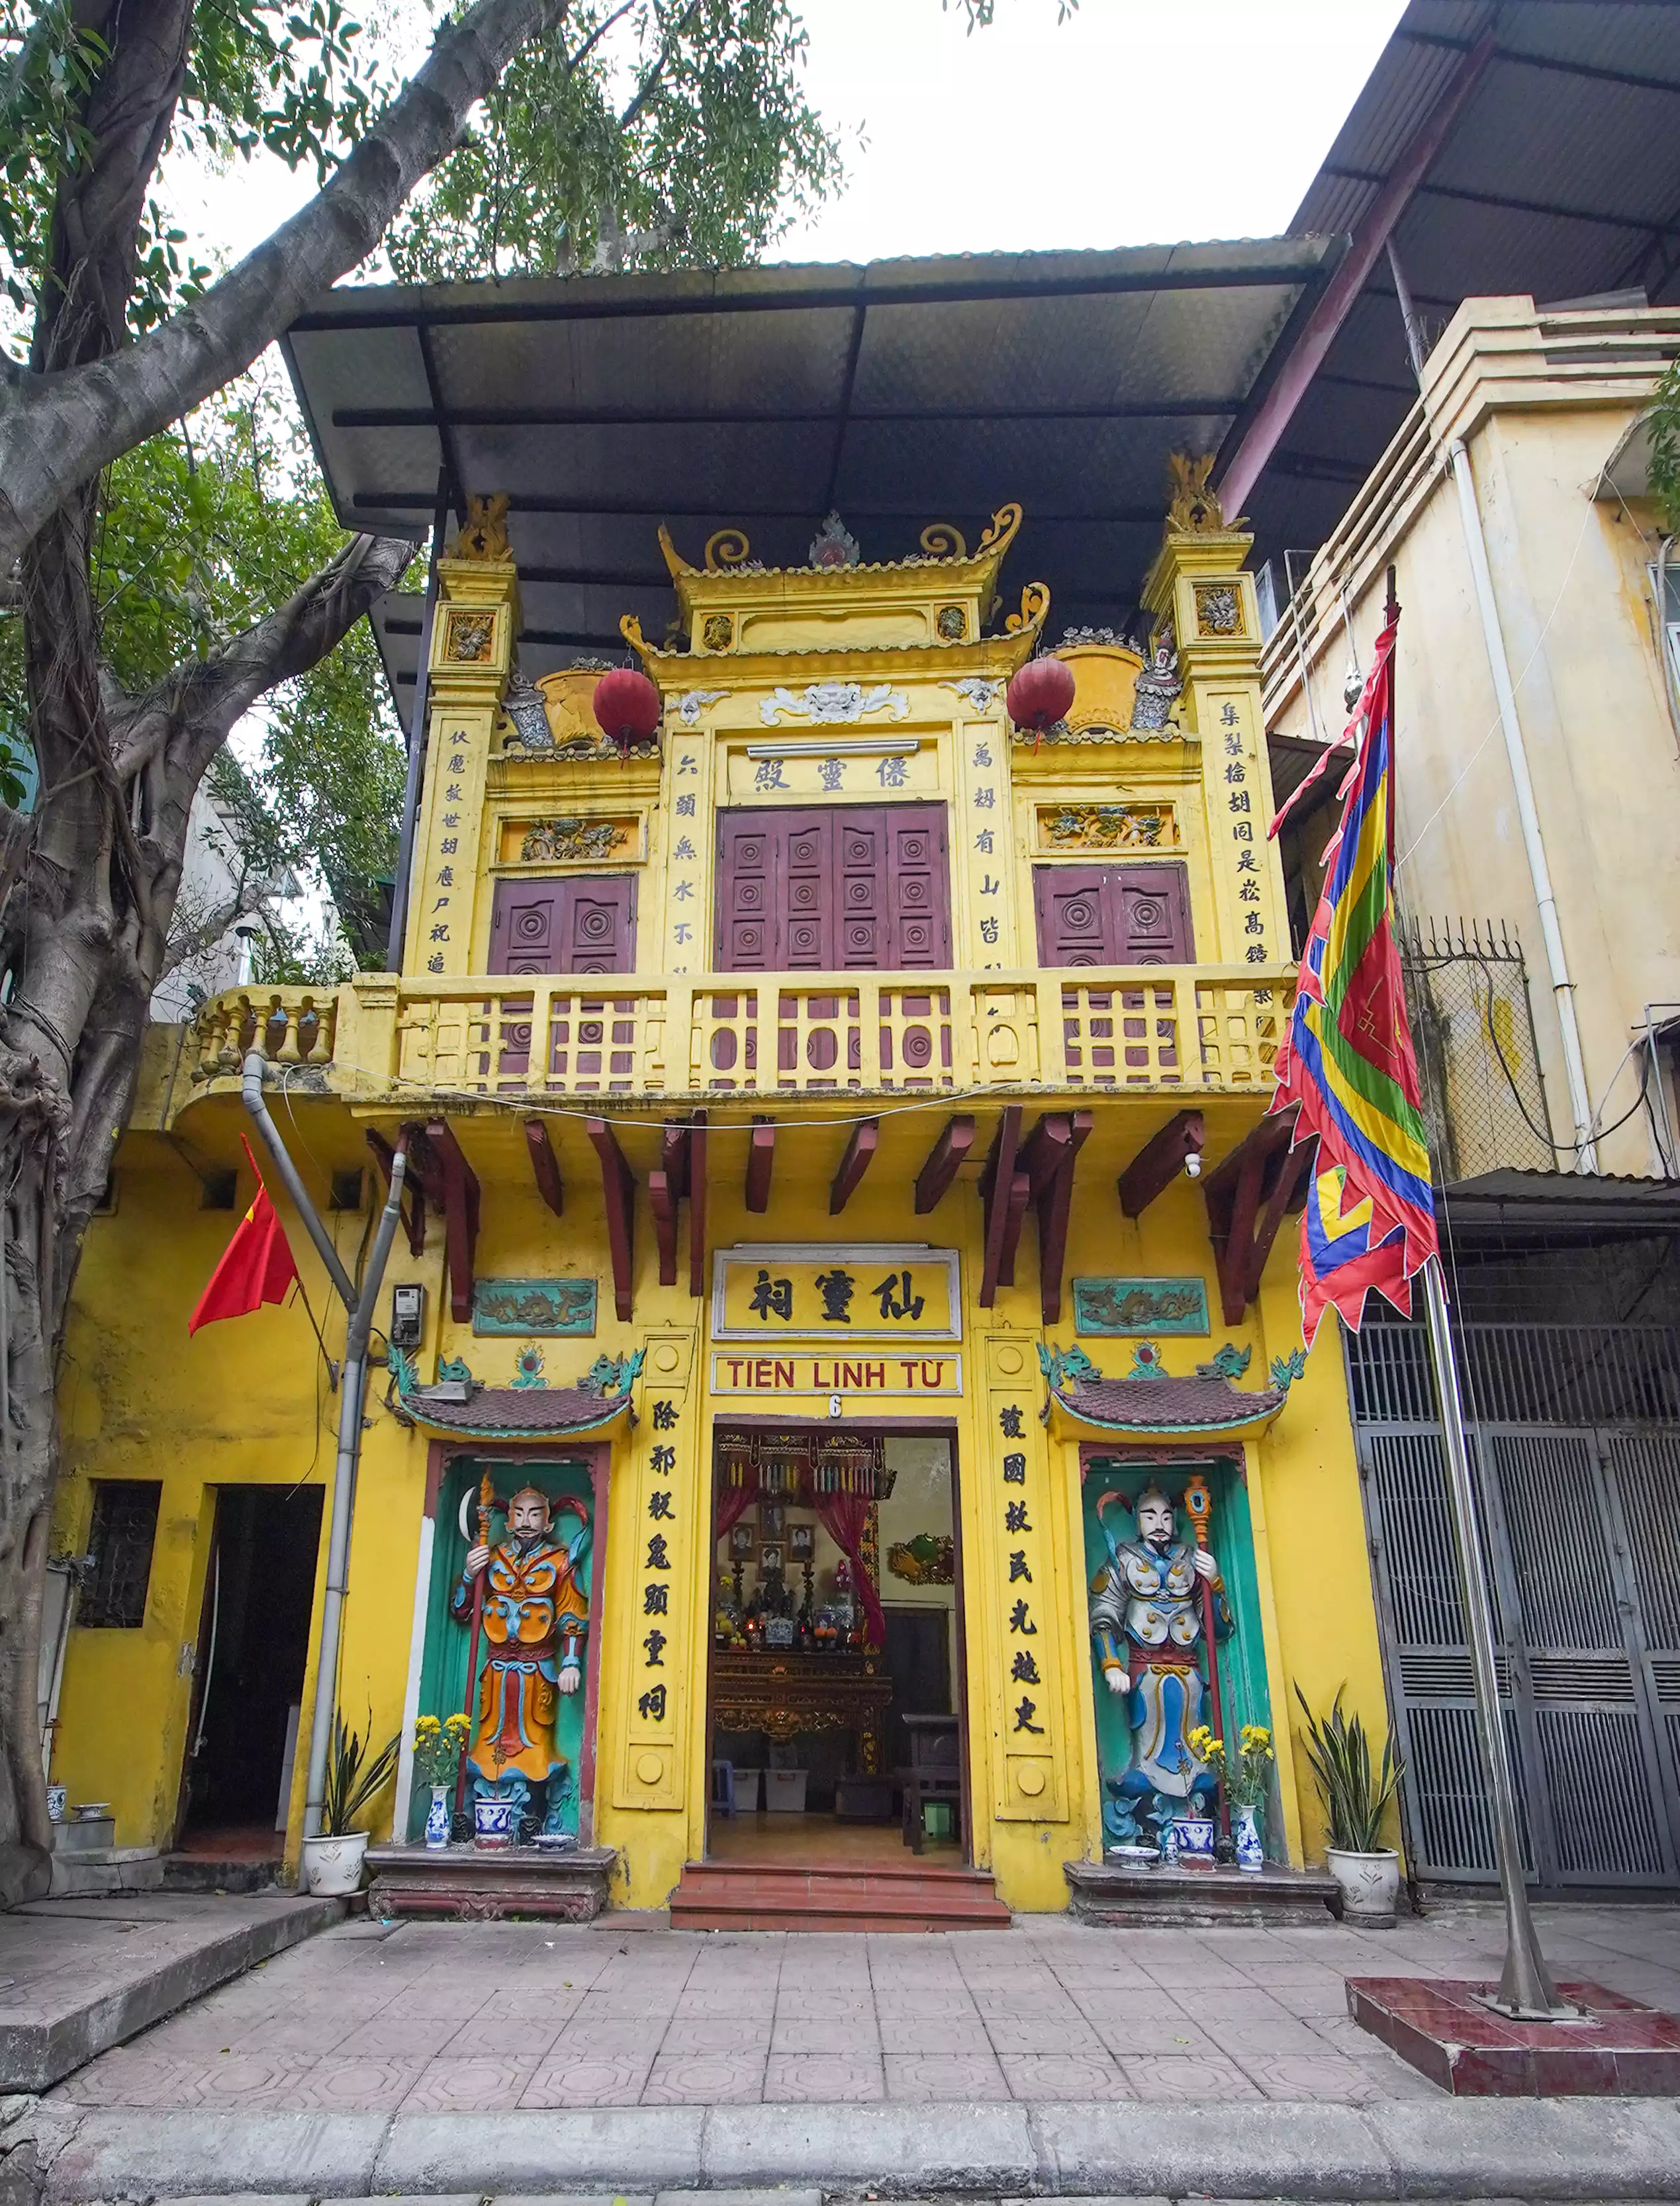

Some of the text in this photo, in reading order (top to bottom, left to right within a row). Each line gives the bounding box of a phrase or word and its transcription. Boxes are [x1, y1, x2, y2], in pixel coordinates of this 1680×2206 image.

[726, 1357, 944, 1389] TIÊN LINH TỪ
[829, 1393, 843, 1418] 6
